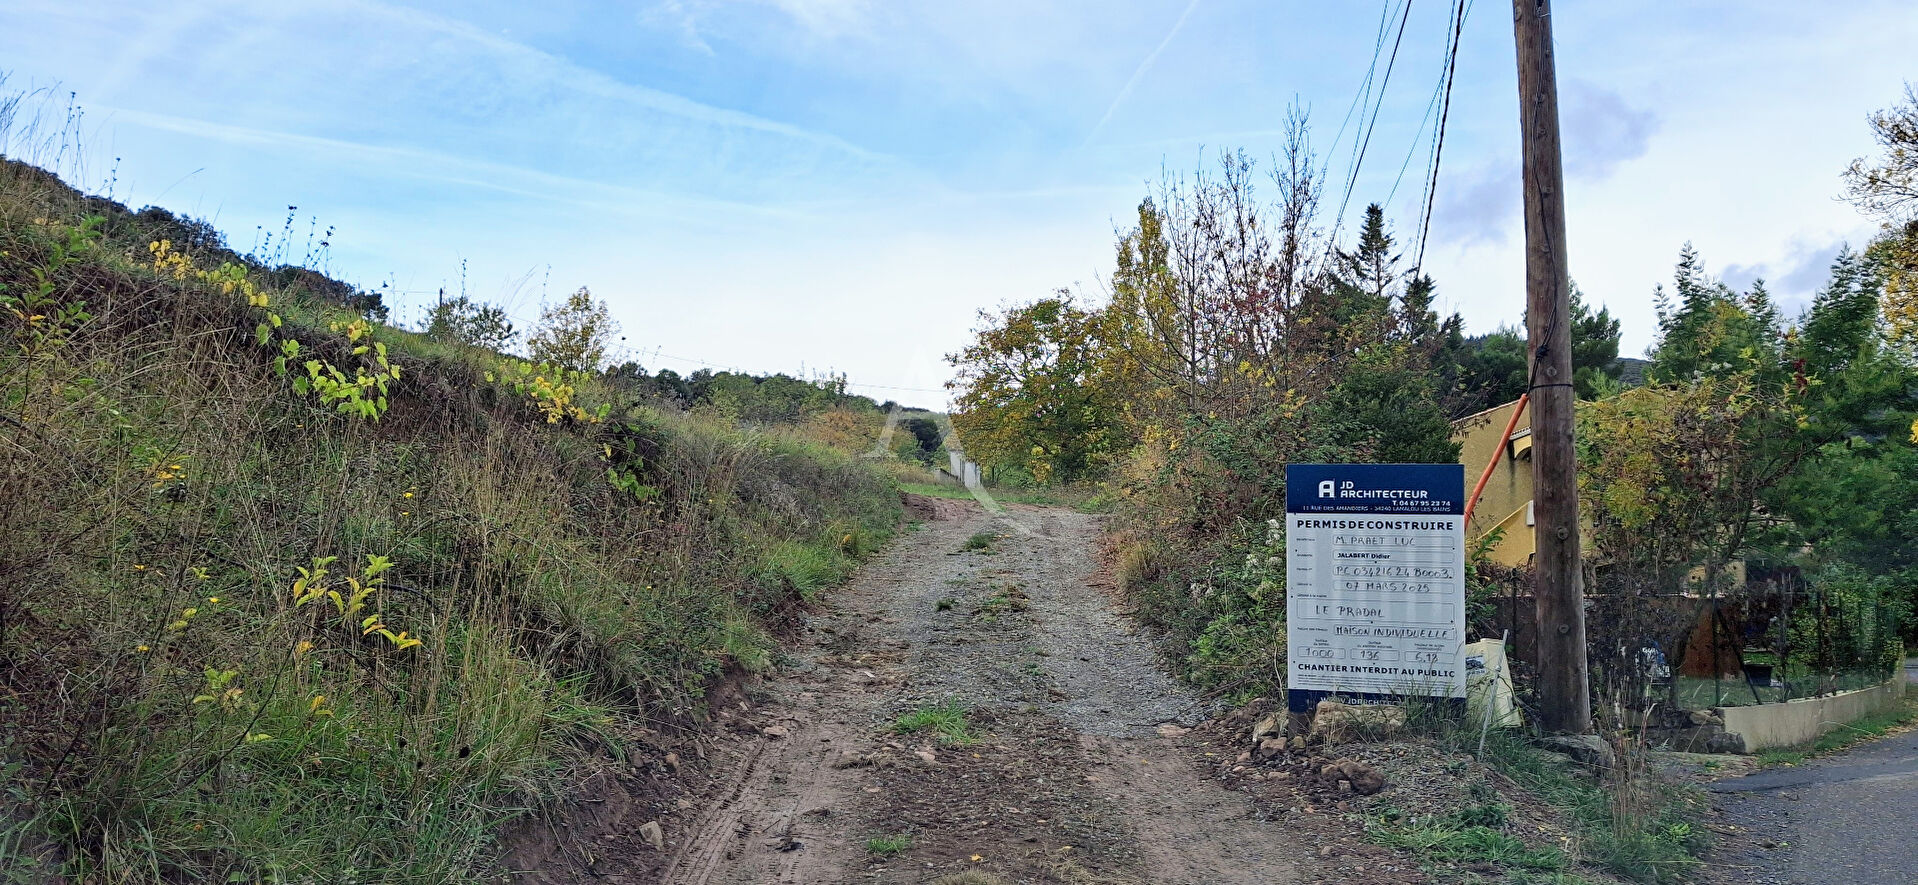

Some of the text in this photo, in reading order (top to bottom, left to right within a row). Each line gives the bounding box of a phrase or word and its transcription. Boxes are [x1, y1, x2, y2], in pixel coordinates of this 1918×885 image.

[1340, 481, 1354, 490] JD
[1340, 490, 1428, 499] ARCHITECTEUR
[1297, 520, 1346, 529] PERMIS
[1366, 521, 1453, 531] CONSTRUIRE
[1336, 566, 1350, 576] PC
[1366, 582, 1398, 591] MARS
[1402, 583, 1430, 592] 2025
[1315, 605, 1385, 618] LE PRADAL
[1336, 626, 1370, 636] MAISON
[1373, 628, 1448, 639] INDIVIDUELLE
[1298, 663, 1348, 673] CHANTIER
[1350, 665, 1399, 675] INTERDIT
[1401, 668, 1415, 676] AU
[1417, 669, 1455, 678] PUBLIC
